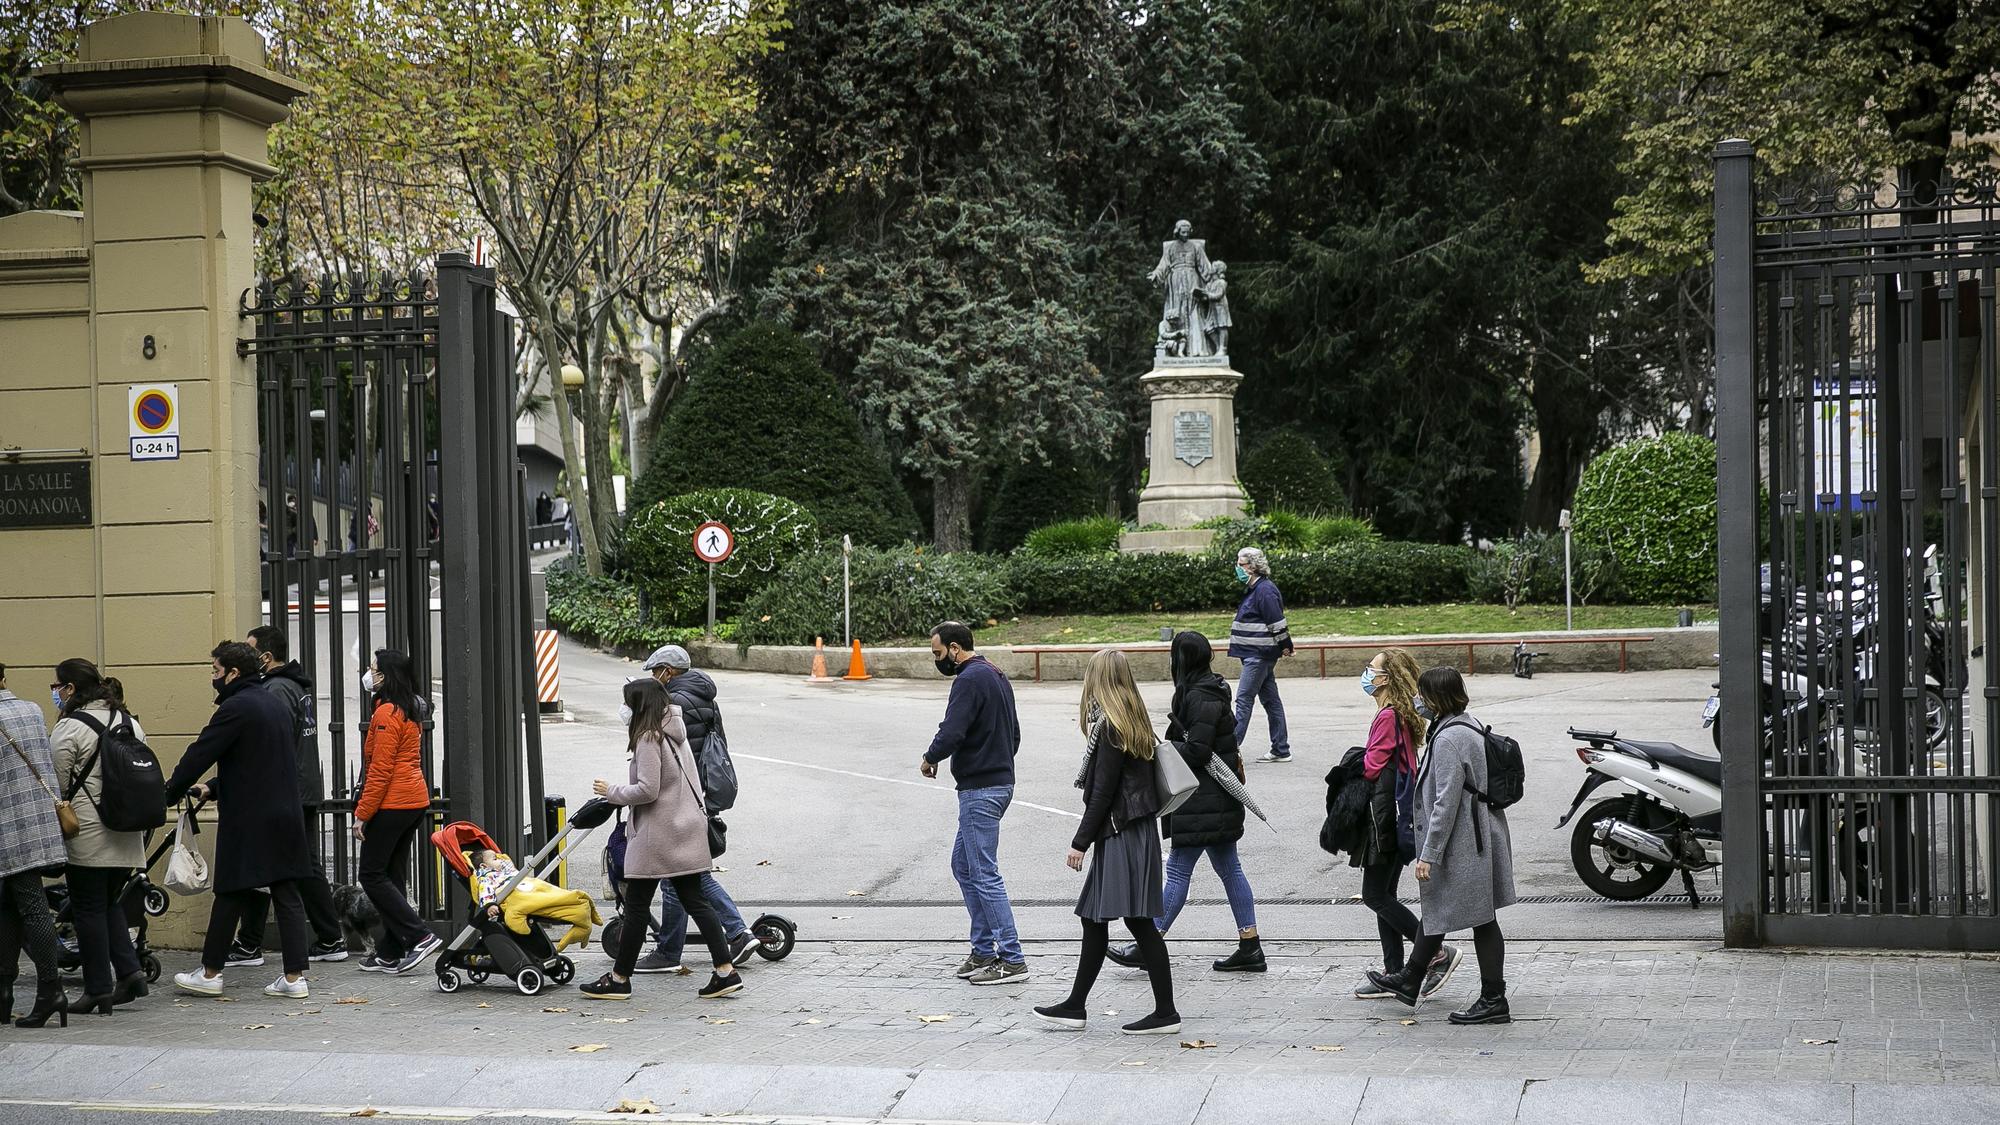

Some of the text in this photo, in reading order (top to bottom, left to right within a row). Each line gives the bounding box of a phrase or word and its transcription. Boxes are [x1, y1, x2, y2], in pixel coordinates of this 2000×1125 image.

[142, 334, 156, 360] 8
[135, 442, 174, 454] 0-24 h
[4, 472, 73, 492] LA SALLE
